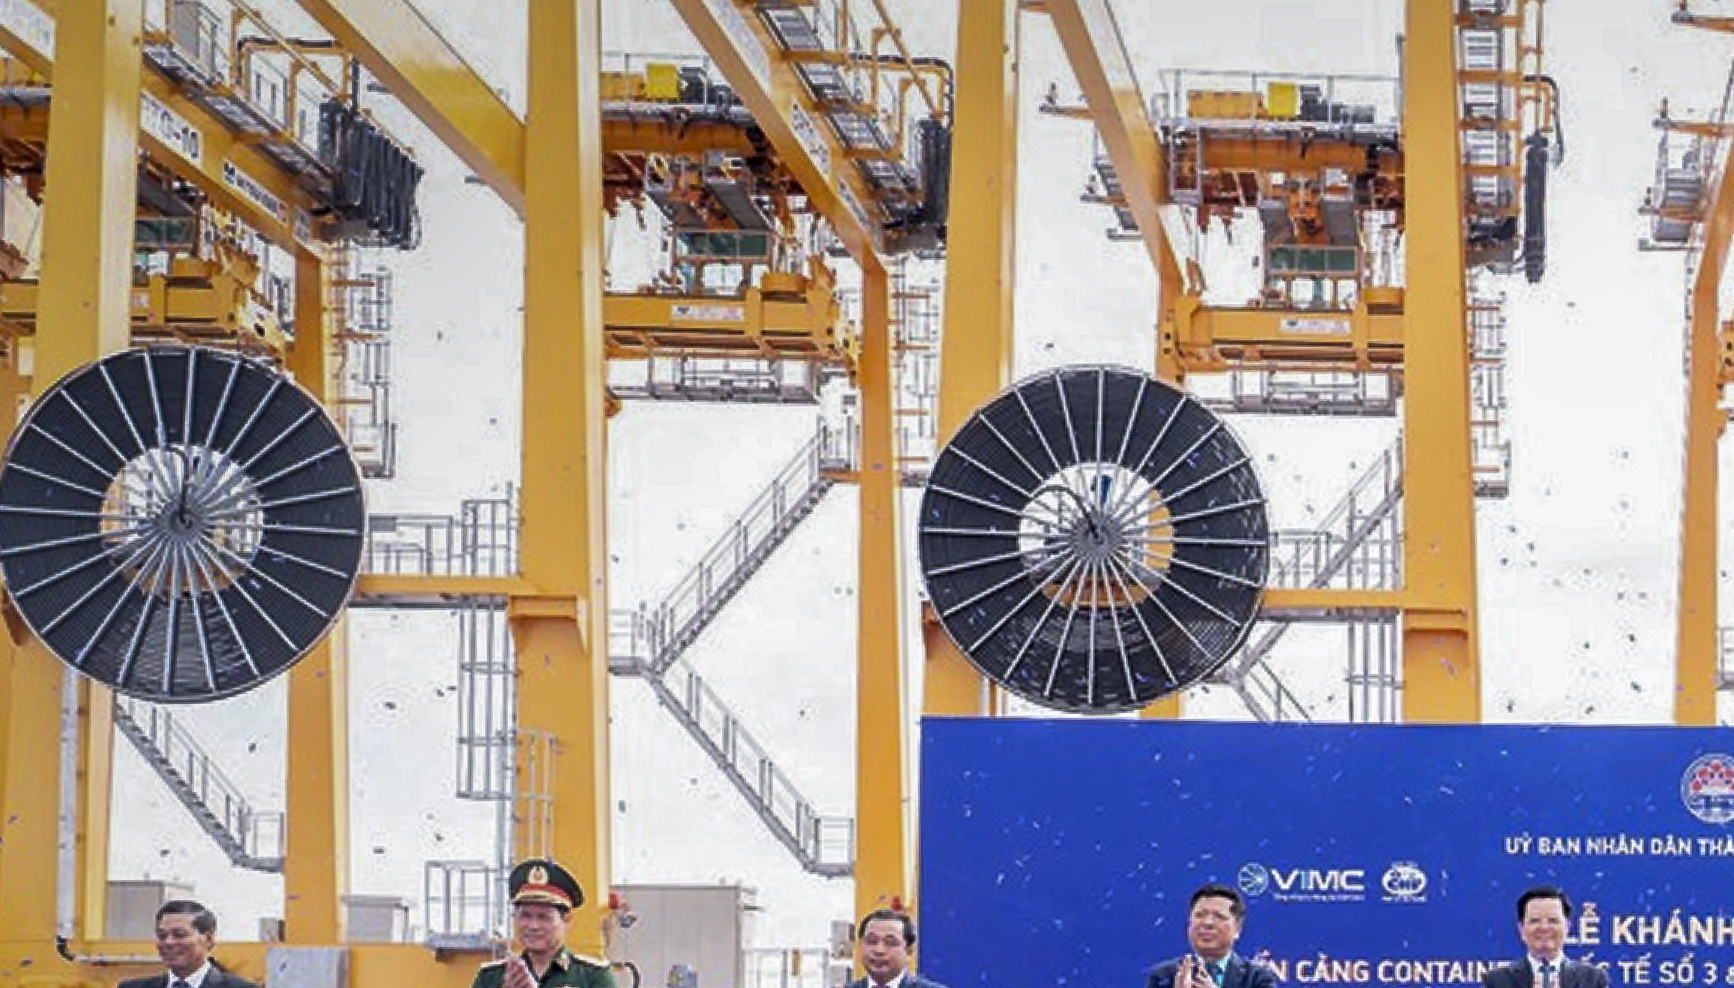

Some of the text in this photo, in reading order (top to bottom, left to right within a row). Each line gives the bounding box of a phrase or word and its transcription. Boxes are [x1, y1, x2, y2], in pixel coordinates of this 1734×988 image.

[1538, 836, 1580, 855] BAN
[1587, 832, 1644, 855] NHÂN
[1651, 833, 1692, 856] DÂN
[1271, 868, 1365, 891] VIMC
[1296, 952, 1370, 983] CẢNG
[1377, 959, 1514, 984] CONTAIN
[1618, 952, 1652, 984] TẾ
[1659, 952, 1694, 985] SỐ
[1703, 961, 1718, 985] 3
